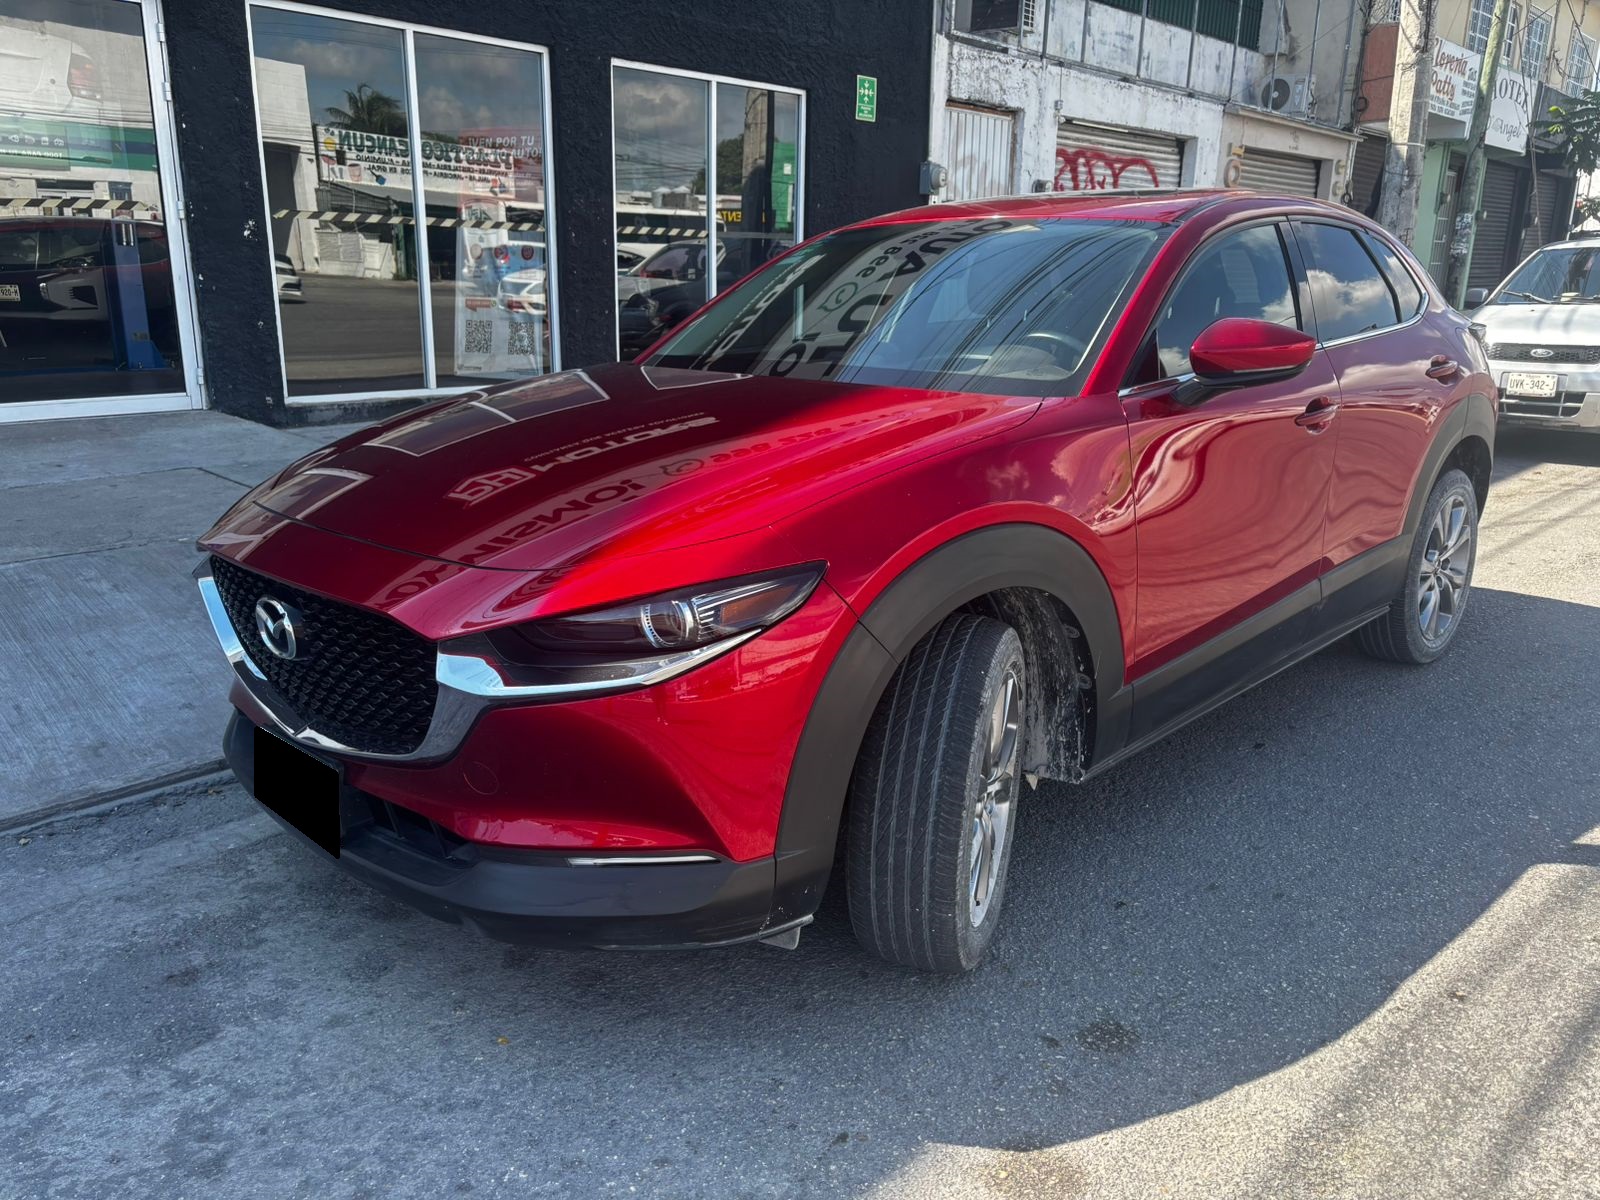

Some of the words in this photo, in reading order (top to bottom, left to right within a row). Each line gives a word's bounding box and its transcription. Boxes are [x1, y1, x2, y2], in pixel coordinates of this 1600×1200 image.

[496, 137, 517, 147] POR
[520, 136, 535, 146] TU
[1509, 378, 1555, 391] UVK-342-J
